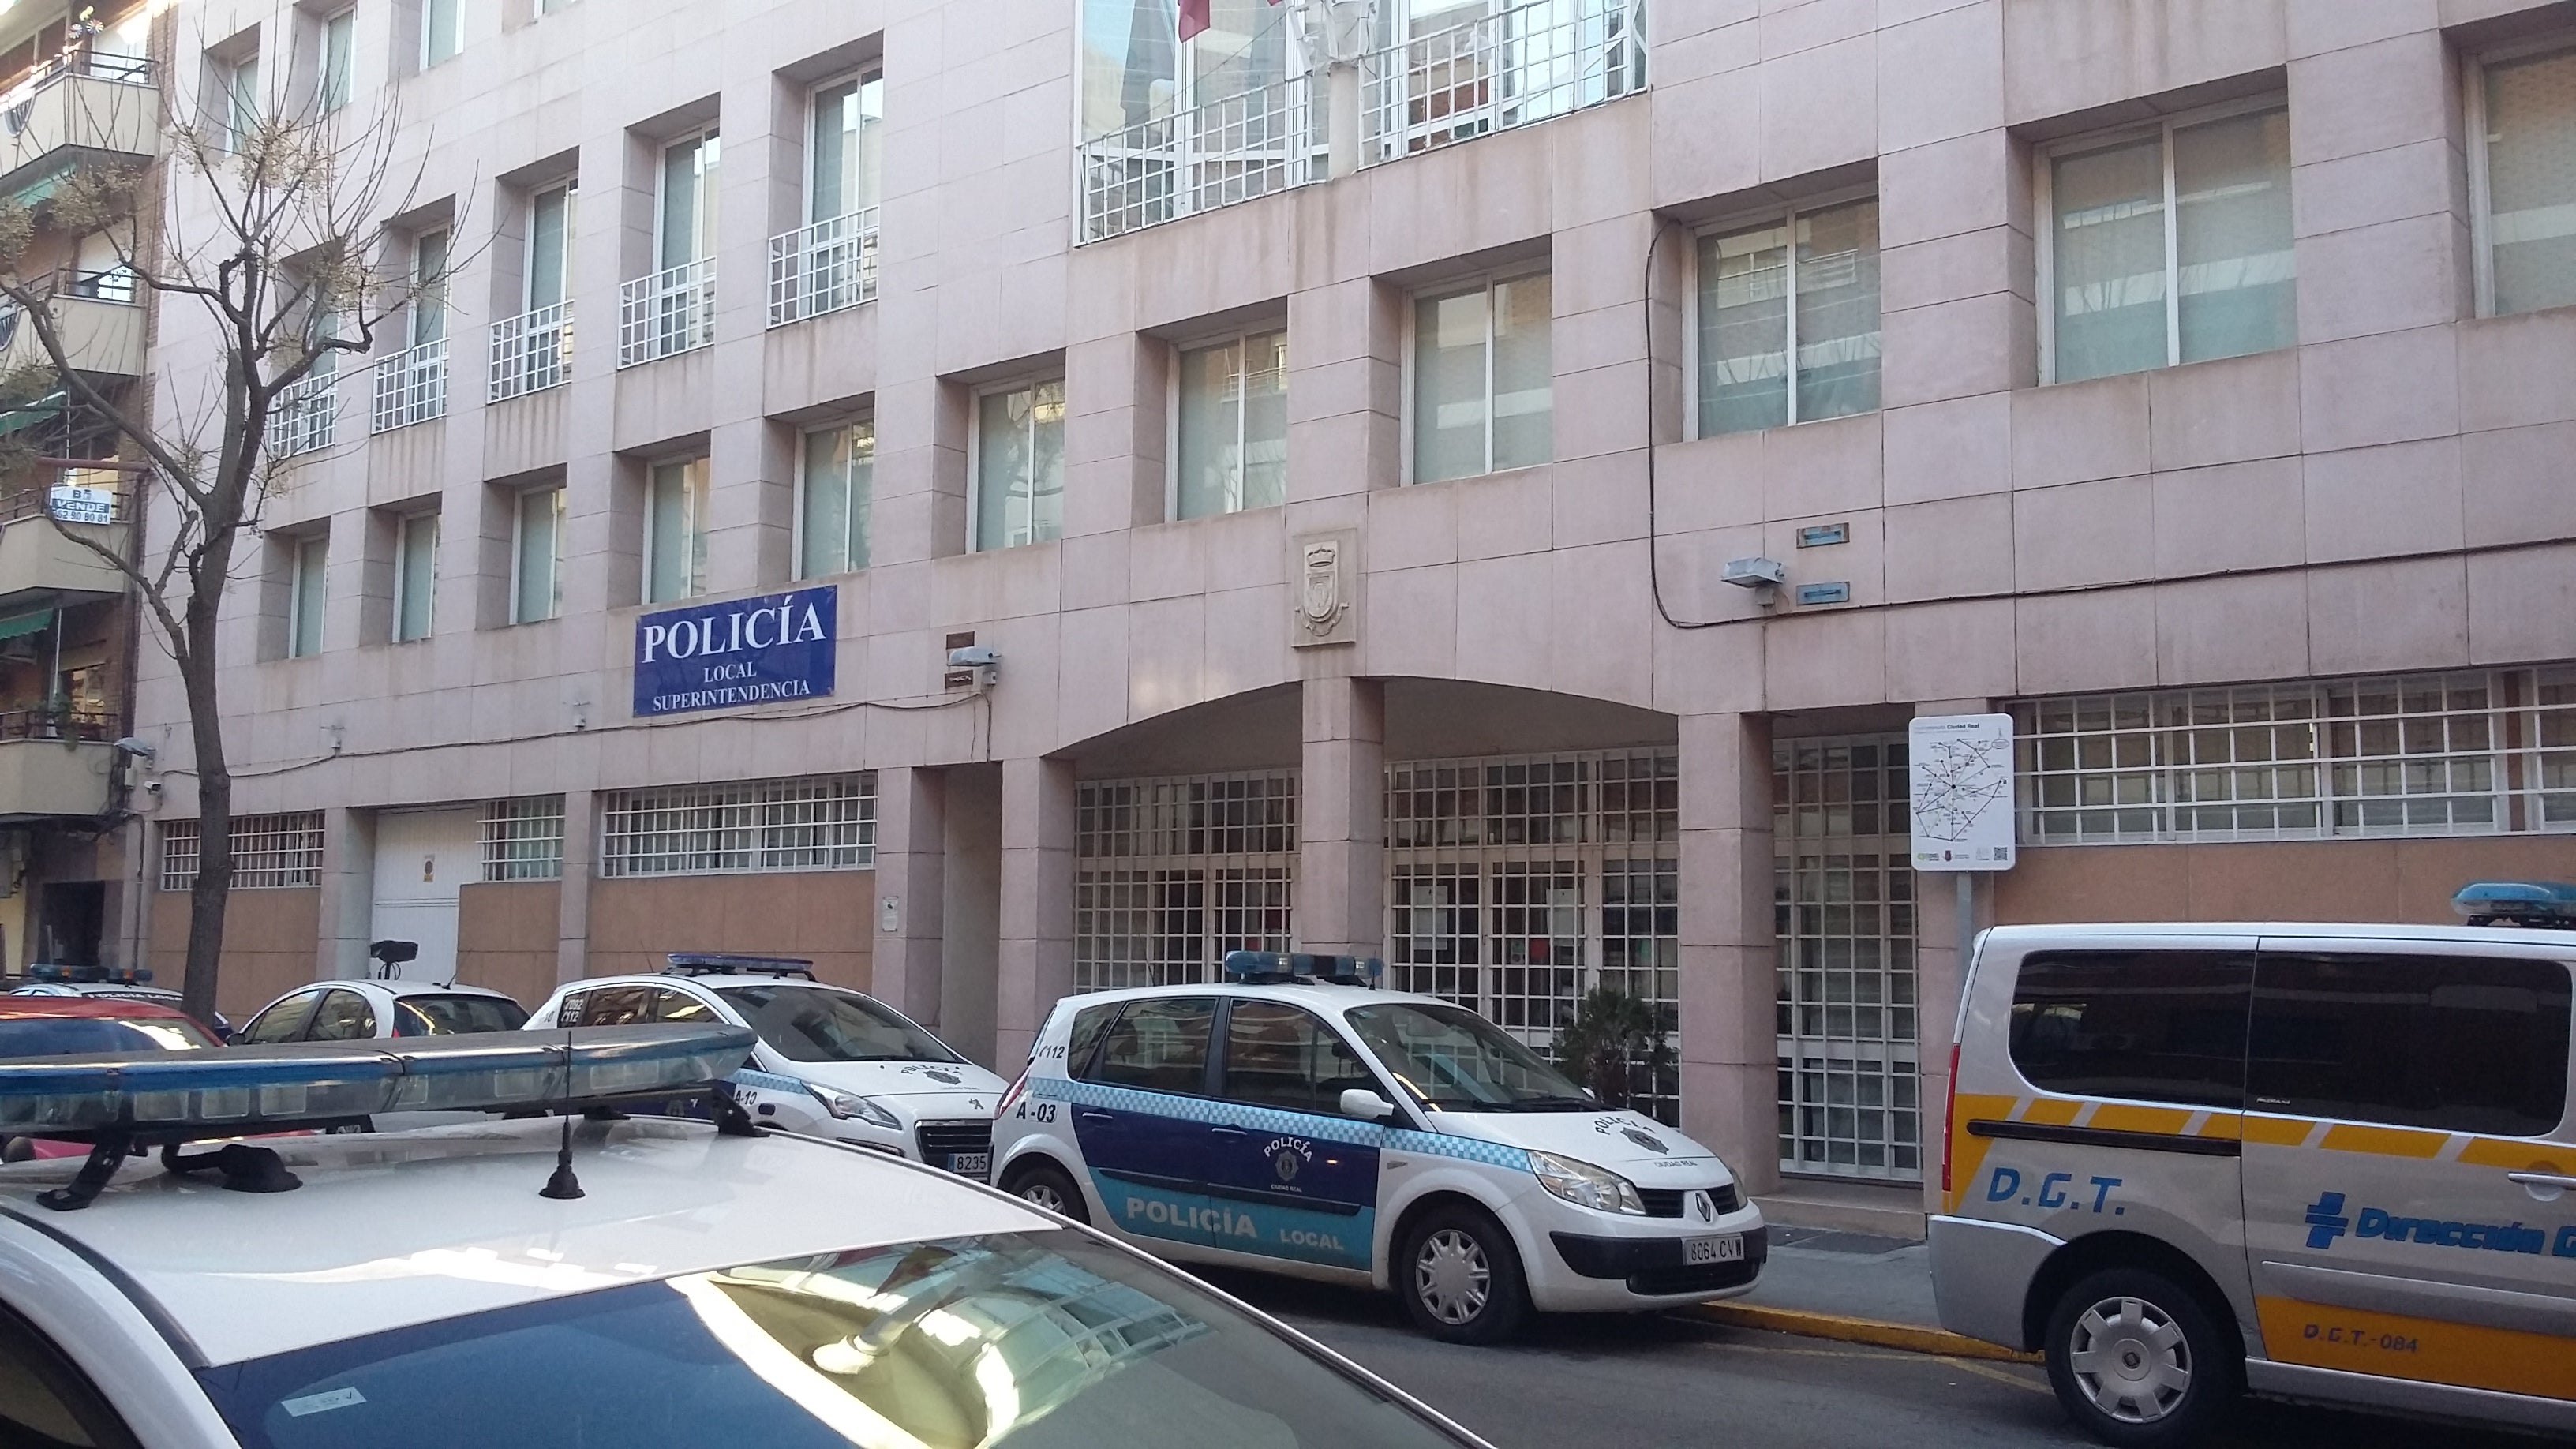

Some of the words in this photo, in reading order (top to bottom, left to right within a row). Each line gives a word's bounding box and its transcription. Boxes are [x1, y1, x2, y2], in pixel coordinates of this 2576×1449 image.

[54, 509, 69, 519] 52
[57, 499, 106, 512] VENDE
[641, 594, 827, 665] POLICÍA
[703, 661, 758, 683] LOCAL
[653, 680, 811, 712] SUPERINTENDENCIA
[1044, 1045, 1065, 1060] 112
[1263, 1136, 1312, 1163] POLICÍA
[957, 1155, 987, 1170] 8235
[1986, 1166, 2125, 1215] D.G.T.
[1126, 1196, 1258, 1239] POLICÍA
[1279, 1228, 1344, 1250] LOCAL
[1691, 1241, 1717, 1261] 8064
